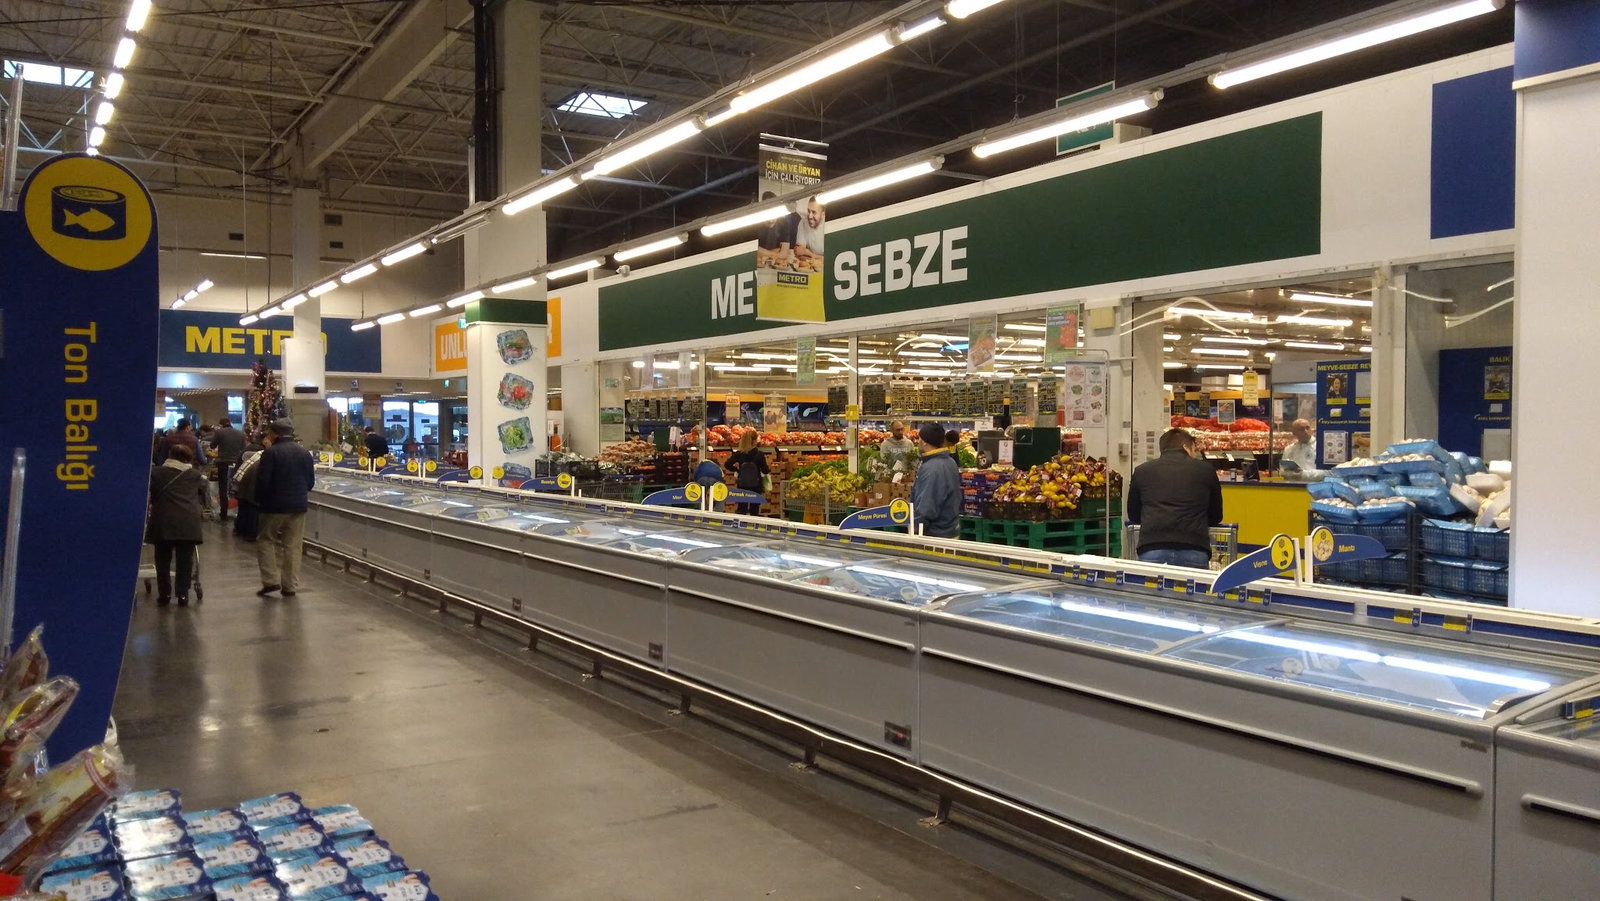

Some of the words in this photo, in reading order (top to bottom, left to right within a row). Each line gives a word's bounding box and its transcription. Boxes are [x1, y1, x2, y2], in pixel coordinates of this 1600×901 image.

[765, 168, 779, 181] İÇİN
[788, 163, 798, 173] VE
[798, 163, 821, 177] ÜRYAN
[711, 270, 757, 320] ME
[833, 225, 968, 301] SEBZE
[778, 273, 807, 284] METRO
[64, 321, 97, 384] Ton
[185, 325, 328, 356] METR
[440, 331, 467, 361] UNL
[56, 399, 98, 490] Balığı
